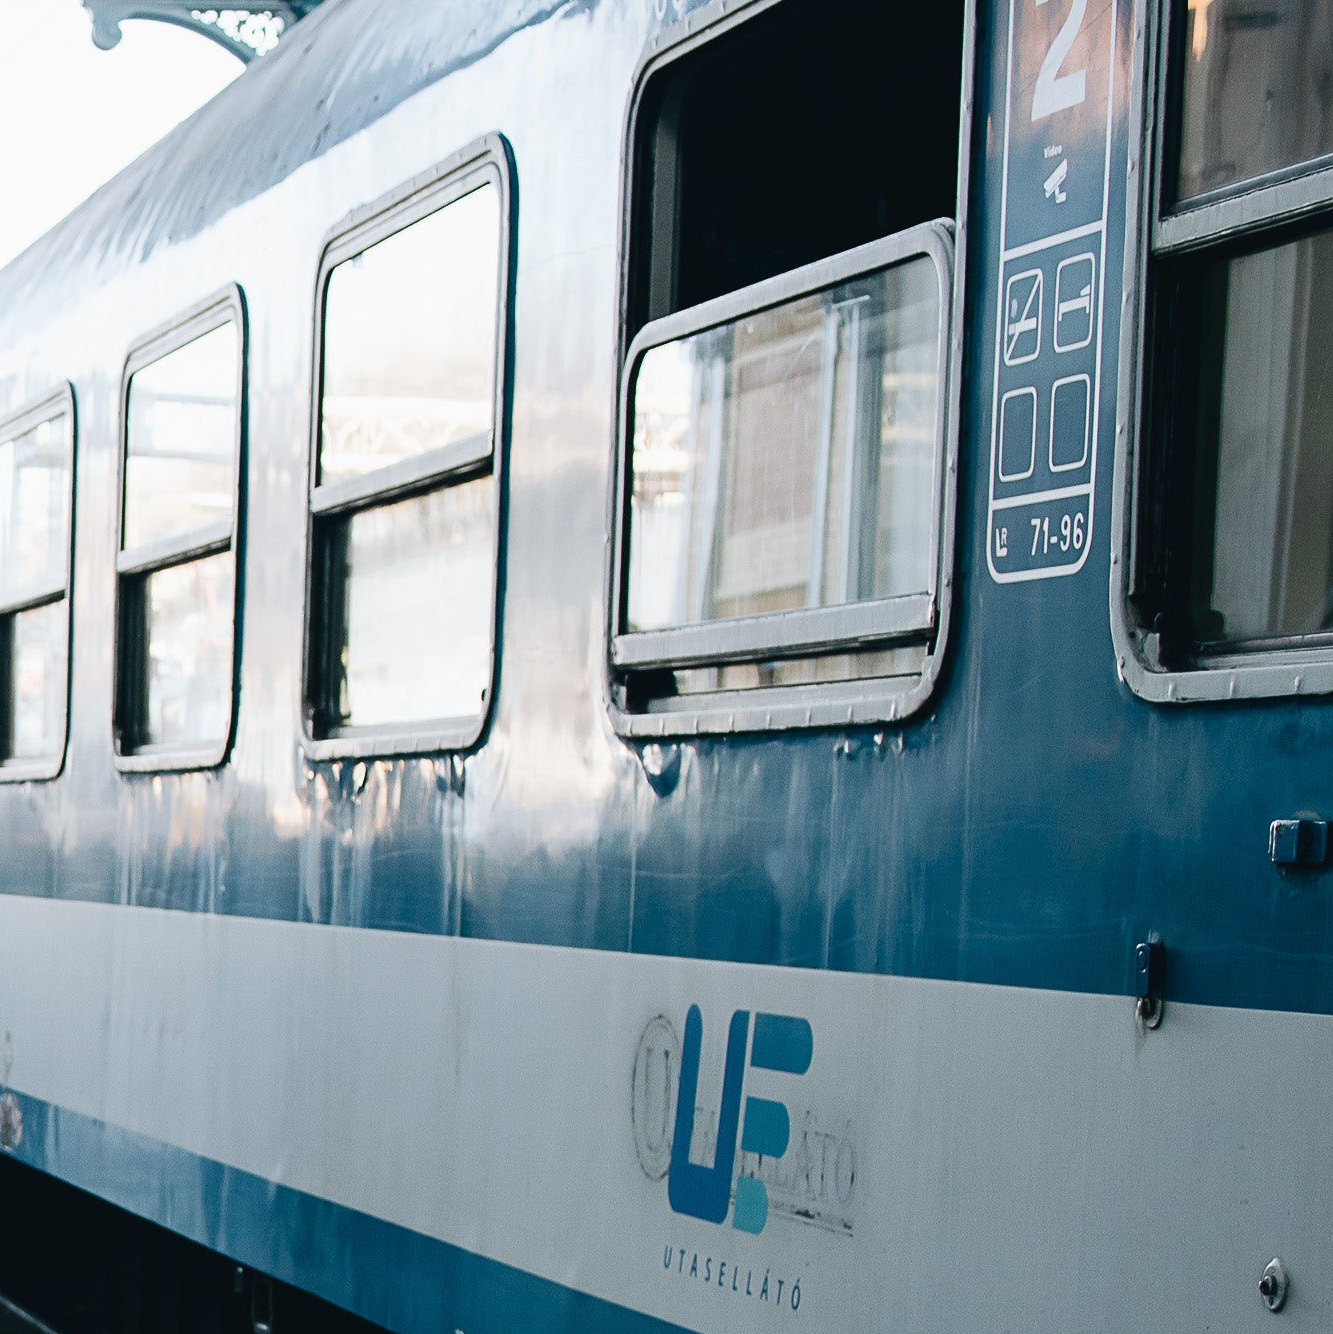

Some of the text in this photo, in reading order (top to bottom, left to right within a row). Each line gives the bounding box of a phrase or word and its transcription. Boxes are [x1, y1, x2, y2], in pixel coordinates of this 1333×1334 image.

[1031, 0, 1087, 122] 2
[1043, 145, 1063, 159] Video
[1030, 512, 1084, 556] 71-96
[663, 1244, 802, 1312] UTASELLÁTÓ
